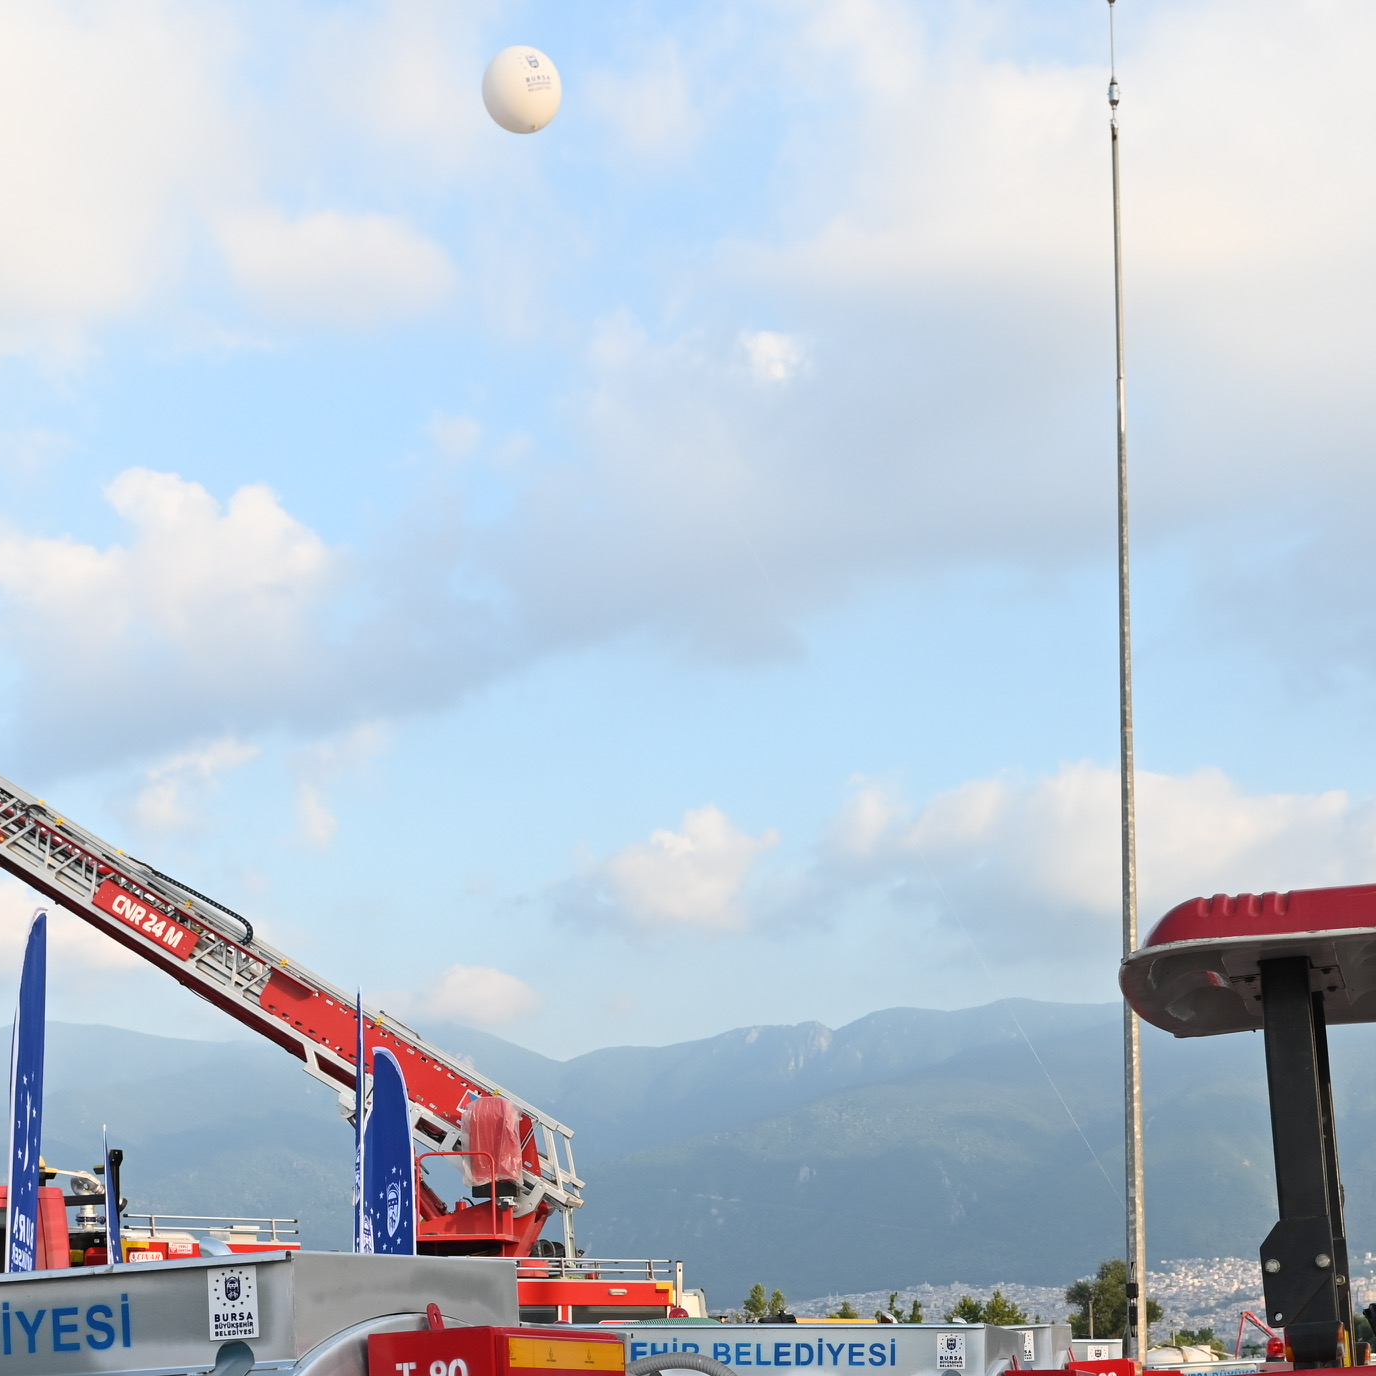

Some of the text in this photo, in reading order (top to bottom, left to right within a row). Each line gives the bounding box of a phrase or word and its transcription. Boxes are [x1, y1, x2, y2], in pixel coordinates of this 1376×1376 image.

[111, 894, 184, 949] CNR 24 M
[215, 1311, 254, 1322] BURSA
[215, 1321, 254, 1330] BÜYÜKŞEHİR
[215, 1327, 255, 1337] BELEDİYESİ
[712, 1337, 896, 1367] BELEDİYESİ
